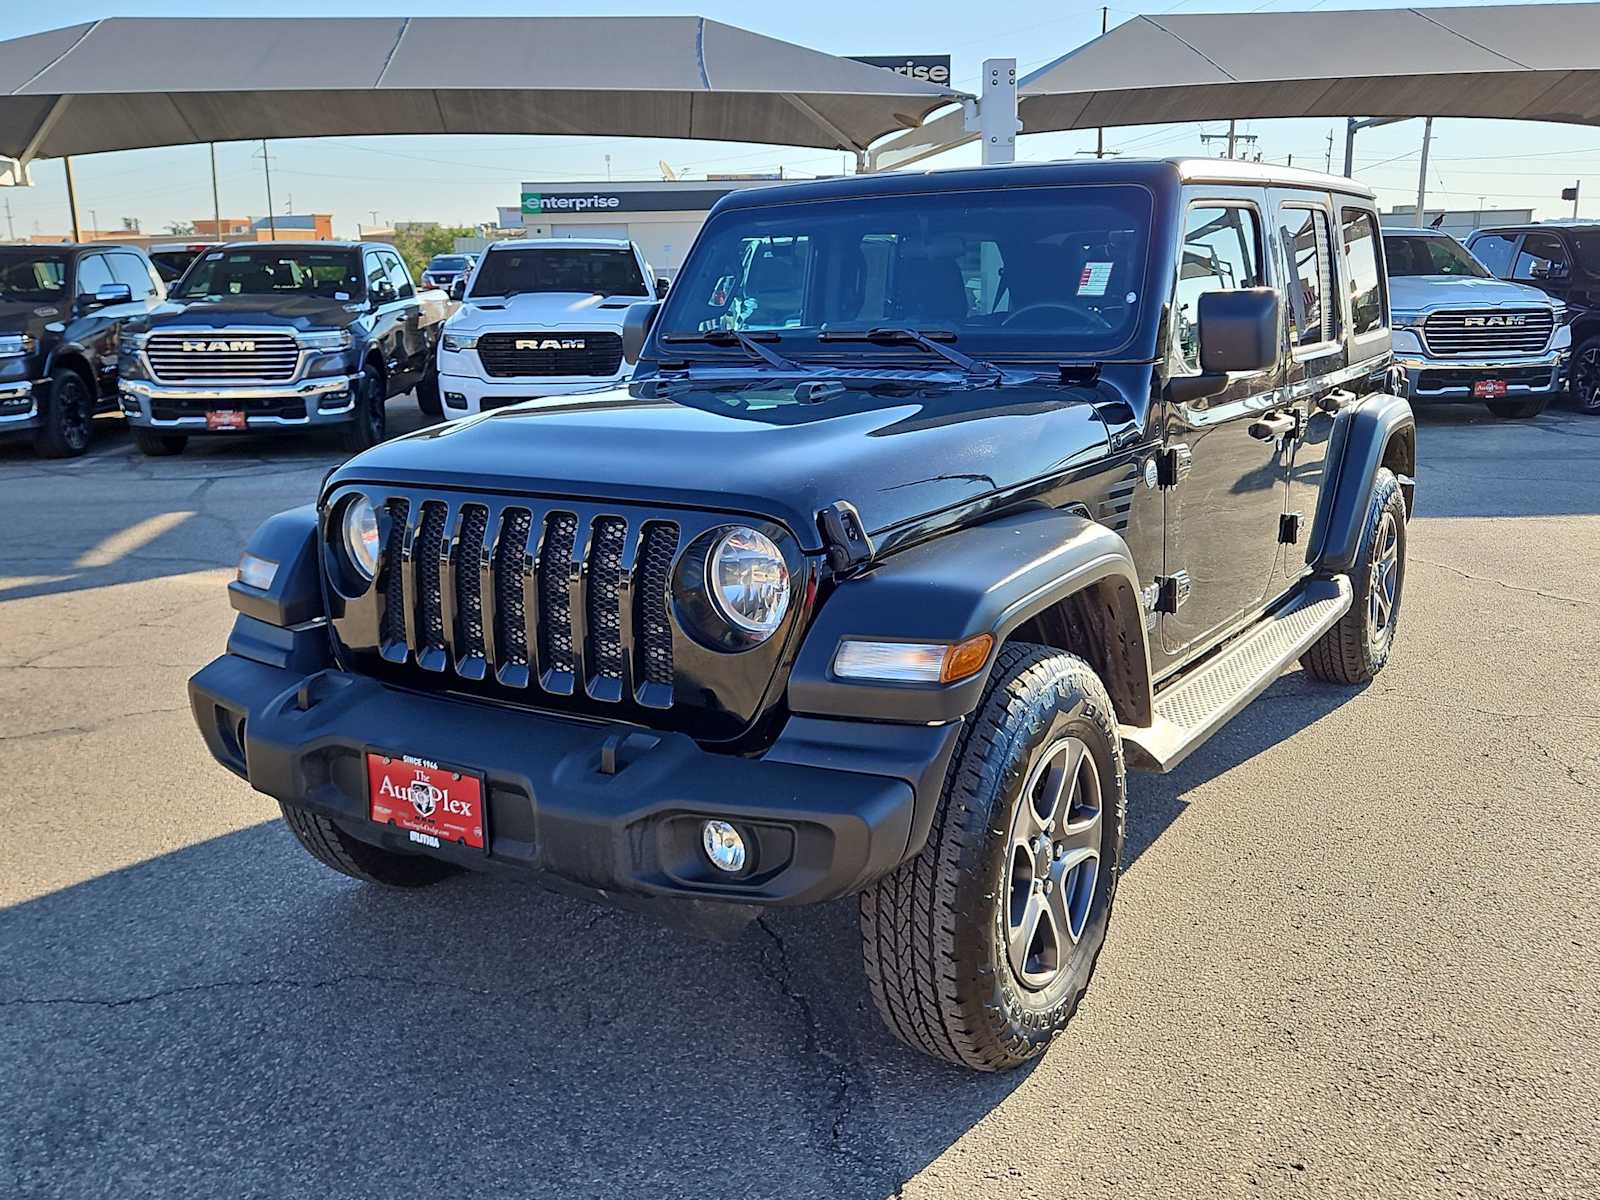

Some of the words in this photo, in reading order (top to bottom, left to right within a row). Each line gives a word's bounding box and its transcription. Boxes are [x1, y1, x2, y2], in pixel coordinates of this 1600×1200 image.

[880, 61, 949, 81] rise
[524, 194, 620, 211] enterprise
[1464, 315, 1526, 327] RAM
[182, 341, 256, 352] RAM
[514, 339, 585, 350] RAM
[414, 770, 431, 782] The
[379, 775, 473, 817] AutoPlex
